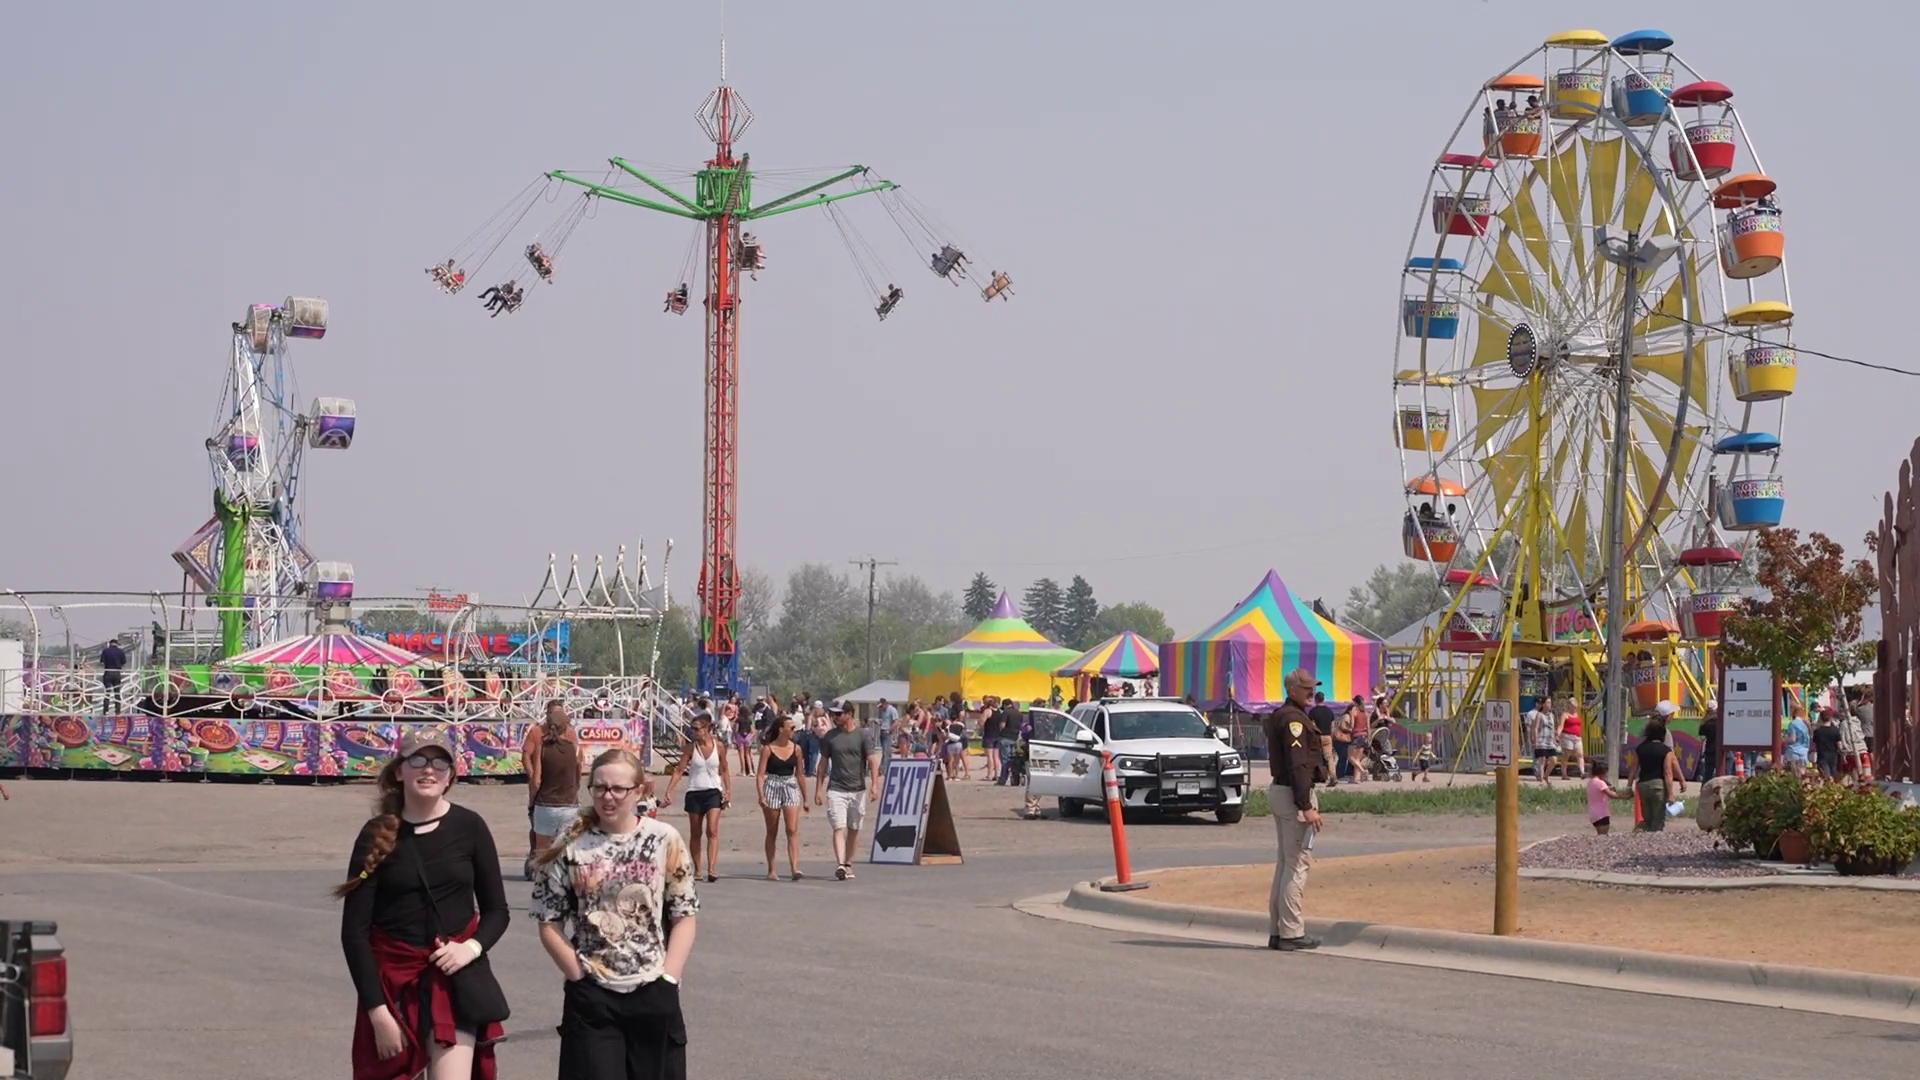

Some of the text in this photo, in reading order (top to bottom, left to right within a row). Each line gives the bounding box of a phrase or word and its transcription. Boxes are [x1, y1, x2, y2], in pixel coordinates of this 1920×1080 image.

[1492, 705, 1504, 718] NO
[1486, 719, 1510, 733] PARKING
[581, 729, 621, 739] CASINO
[1491, 743, 1505, 753] TIME
[882, 766, 928, 815] EXIT
